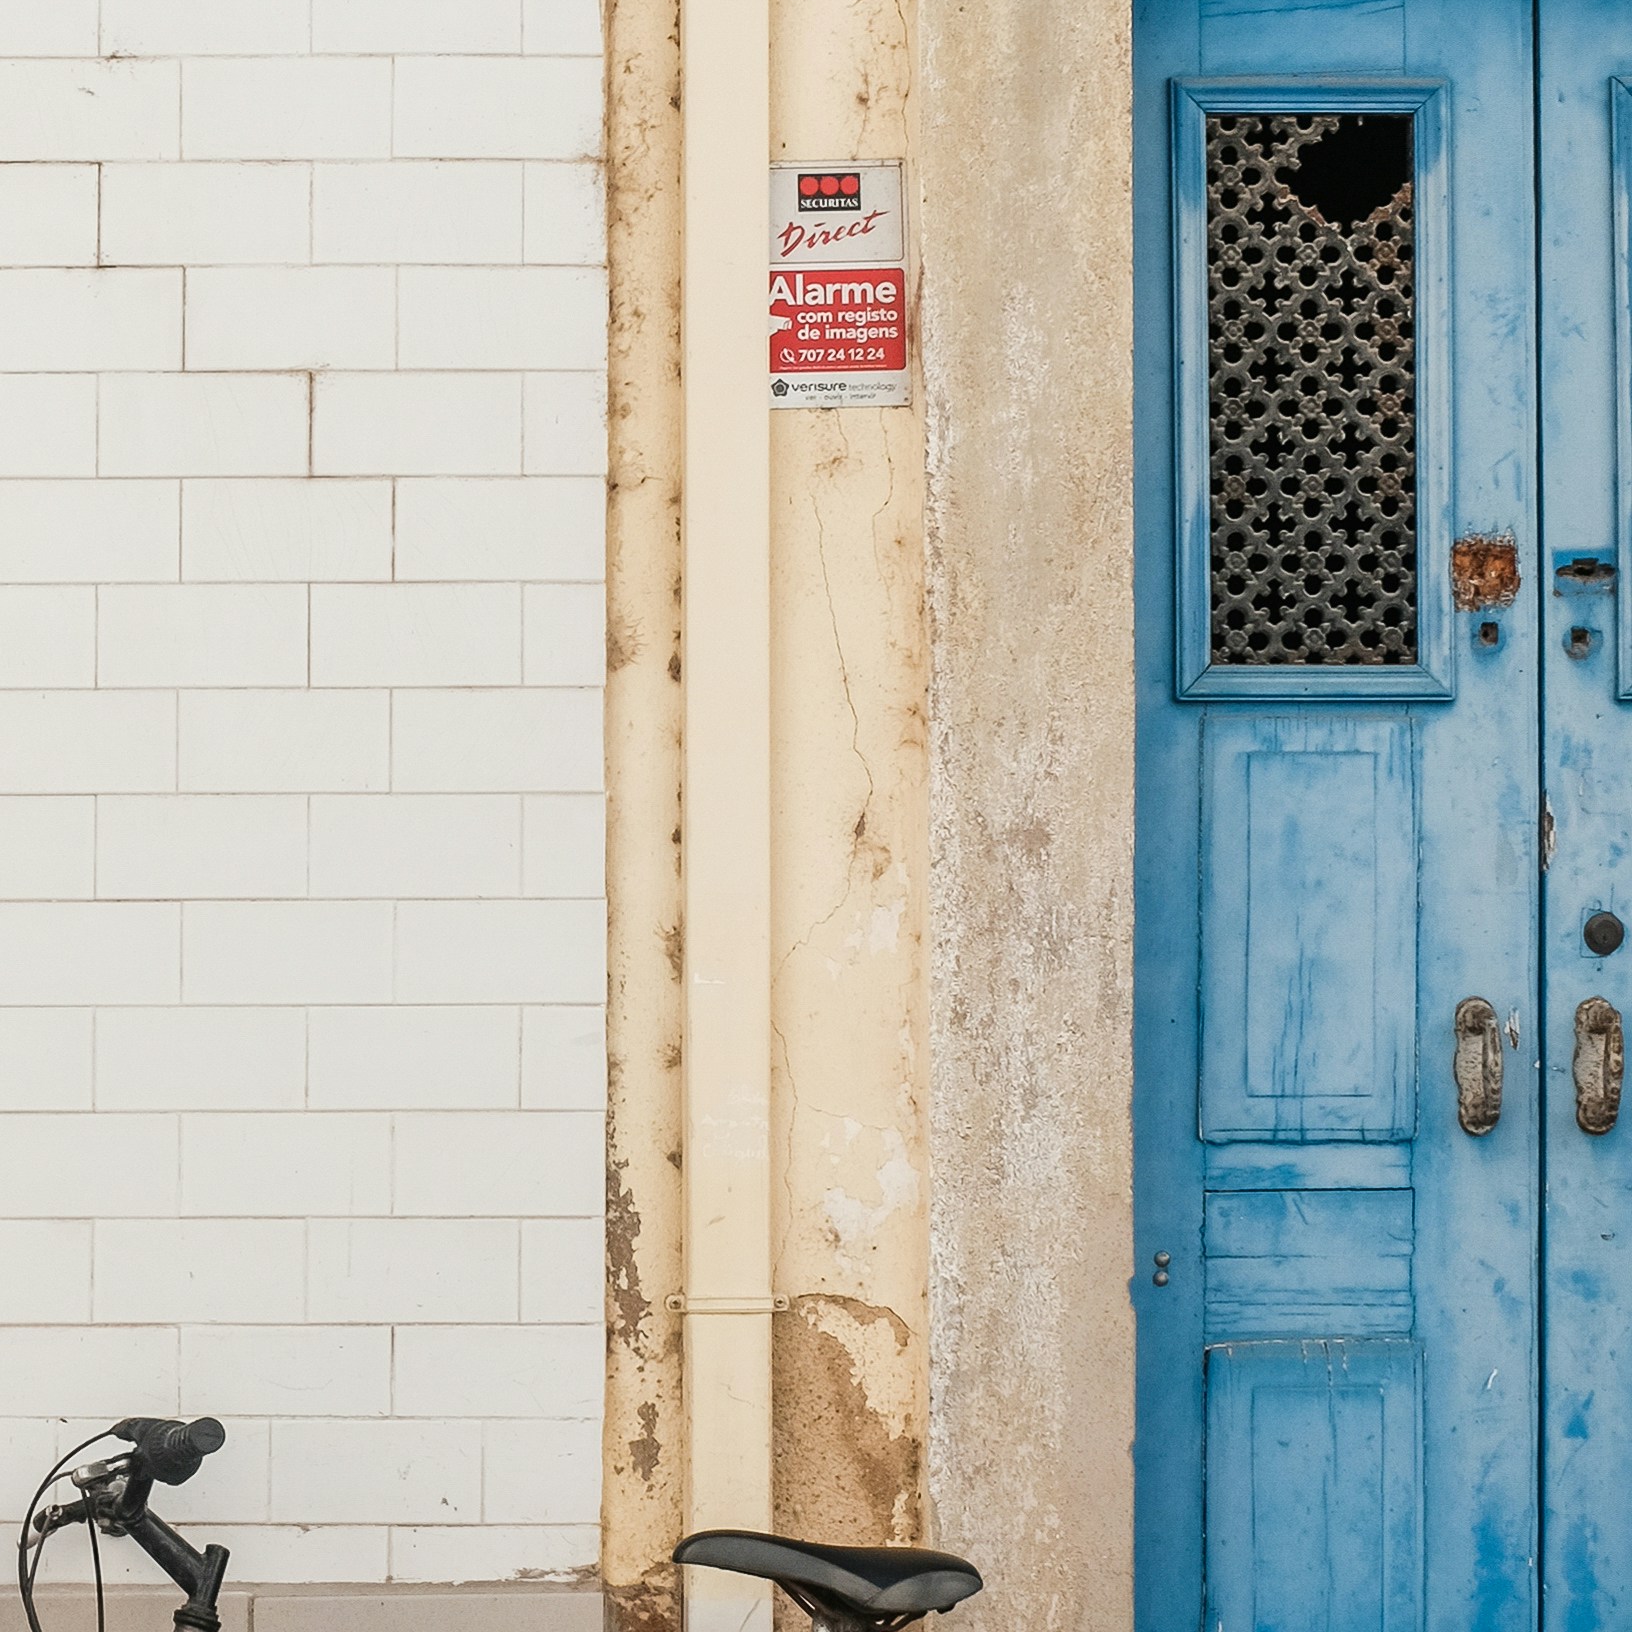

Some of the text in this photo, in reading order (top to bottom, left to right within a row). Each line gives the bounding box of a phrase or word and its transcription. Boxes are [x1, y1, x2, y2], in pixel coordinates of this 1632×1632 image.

[800, 197, 859, 209] SECURITAS
[776, 209, 891, 257] Direct
[768, 273, 897, 306] Alarme
[796, 307, 898, 326] com registo
[797, 324, 899, 343] de imagens
[798, 348, 885, 362] 707 24 12 24
[790, 381, 847, 393] verisure
